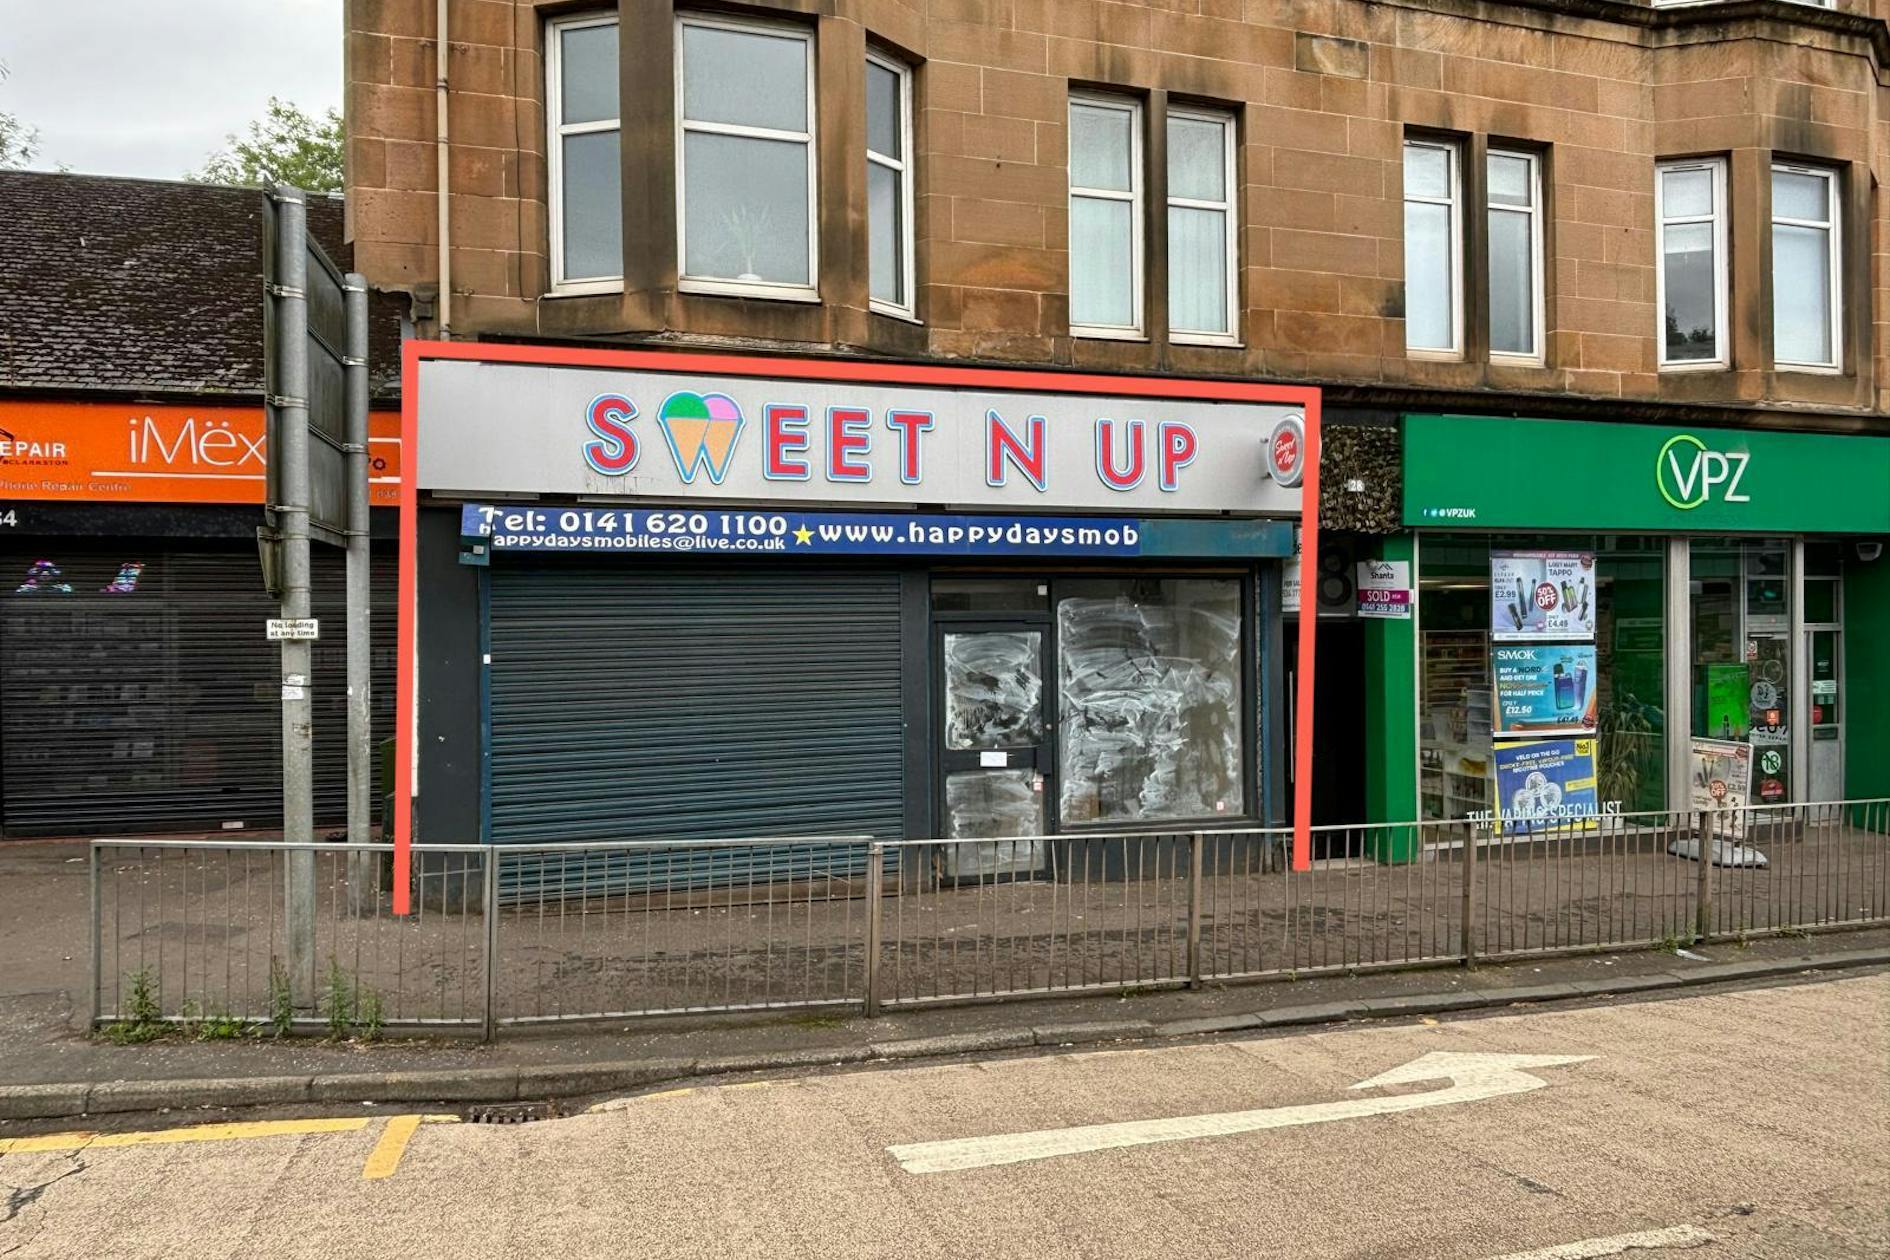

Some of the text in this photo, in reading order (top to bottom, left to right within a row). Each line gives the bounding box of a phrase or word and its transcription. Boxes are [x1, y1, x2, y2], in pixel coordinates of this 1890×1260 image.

[583, 390, 1199, 492] SWEET N UP
[1667, 450, 1751, 502] VPZ
[0, 509, 17, 527] 4
[478, 507, 787, 536] Tel: 0141 620 1100
[818, 522, 1138, 546] www.happydaysmob
[1367, 590, 1390, 602] SOLD
[1538, 594, 1556, 607] OFF
[1497, 650, 1536, 660] SMOK
